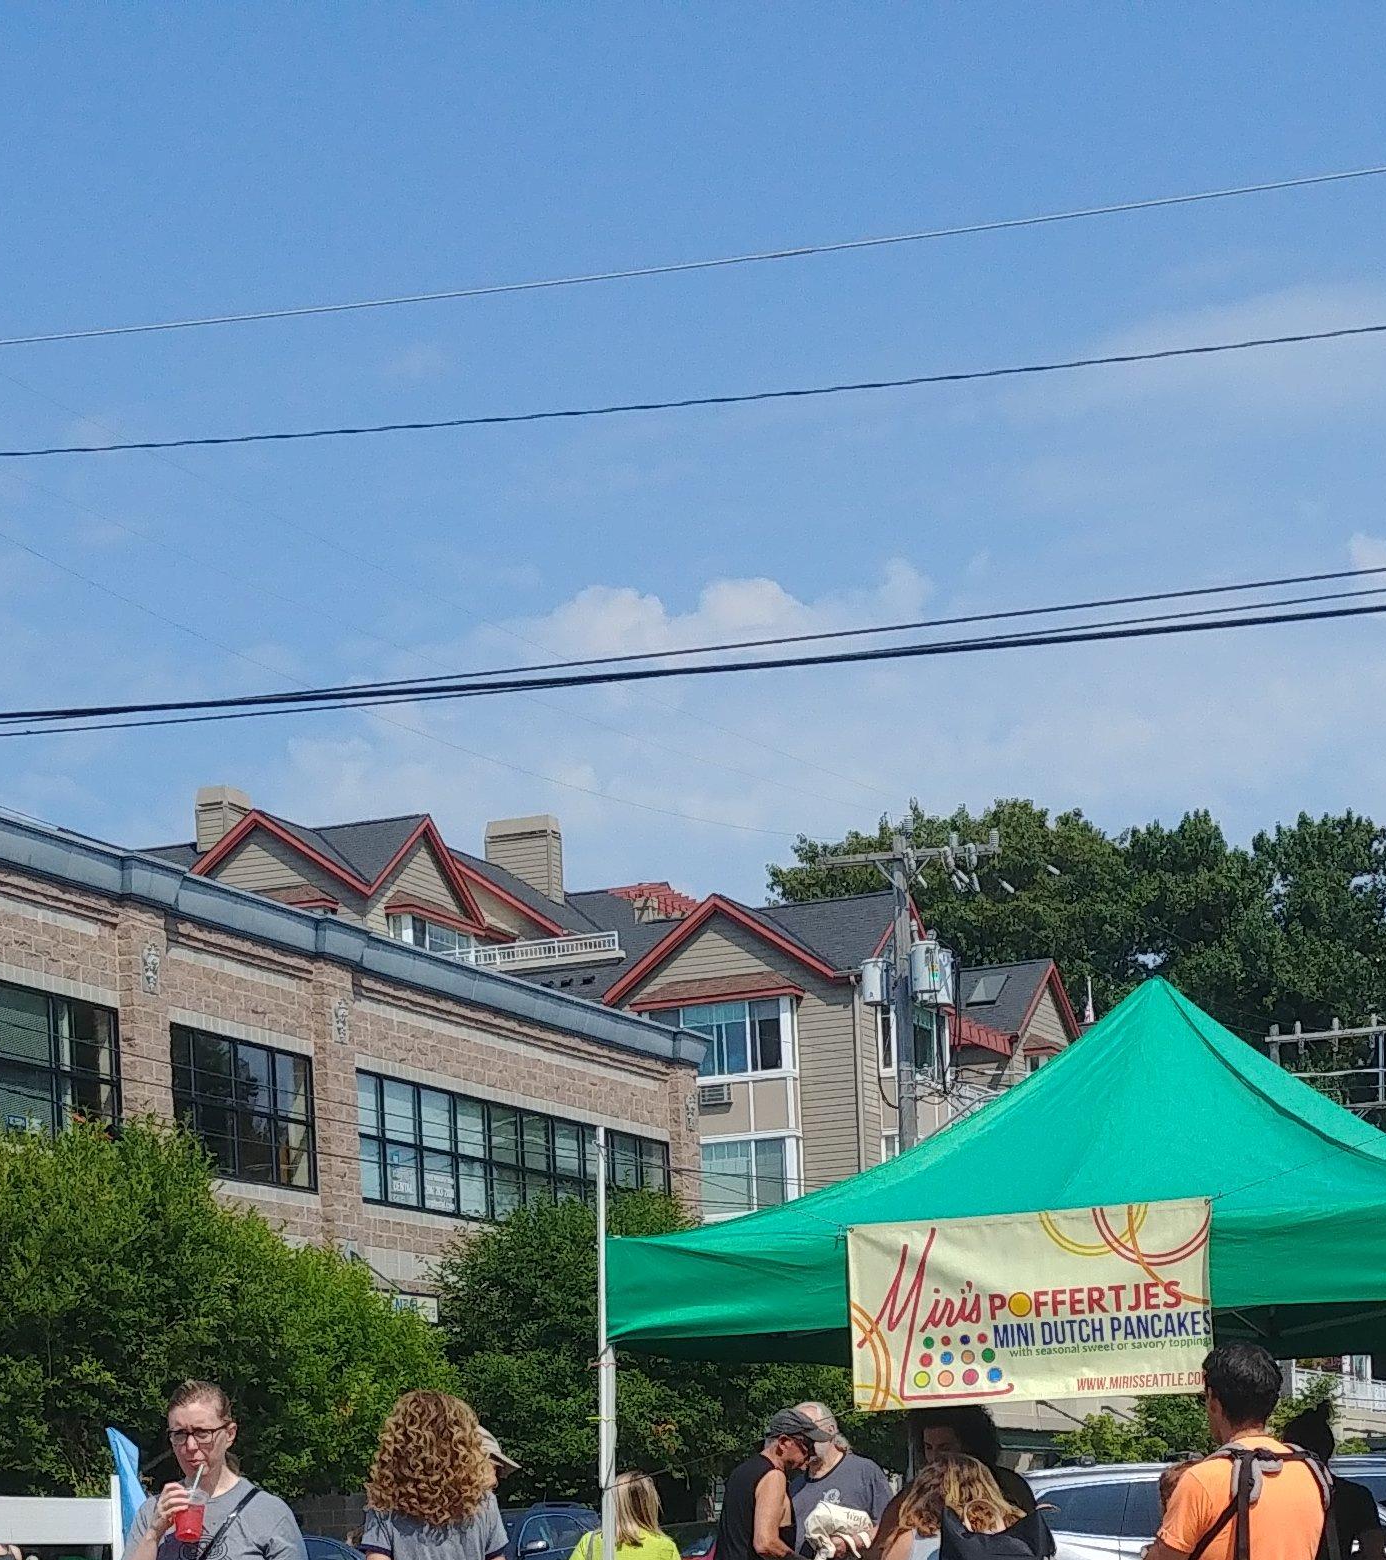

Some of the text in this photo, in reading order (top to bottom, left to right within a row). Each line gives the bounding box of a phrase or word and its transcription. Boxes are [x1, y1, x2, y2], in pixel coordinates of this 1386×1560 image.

[988, 1280, 1183, 1321] POFFERTJES
[993, 1310, 1212, 1350] MINI DUTCH PANCAKES
[1009, 1346, 1033, 1358] with
[1035, 1344, 1080, 1357] seasonal
[1082, 1342, 1114, 1354] sweet
[1117, 1341, 1129, 1351] or
[1131, 1339, 1167, 1351] savory
